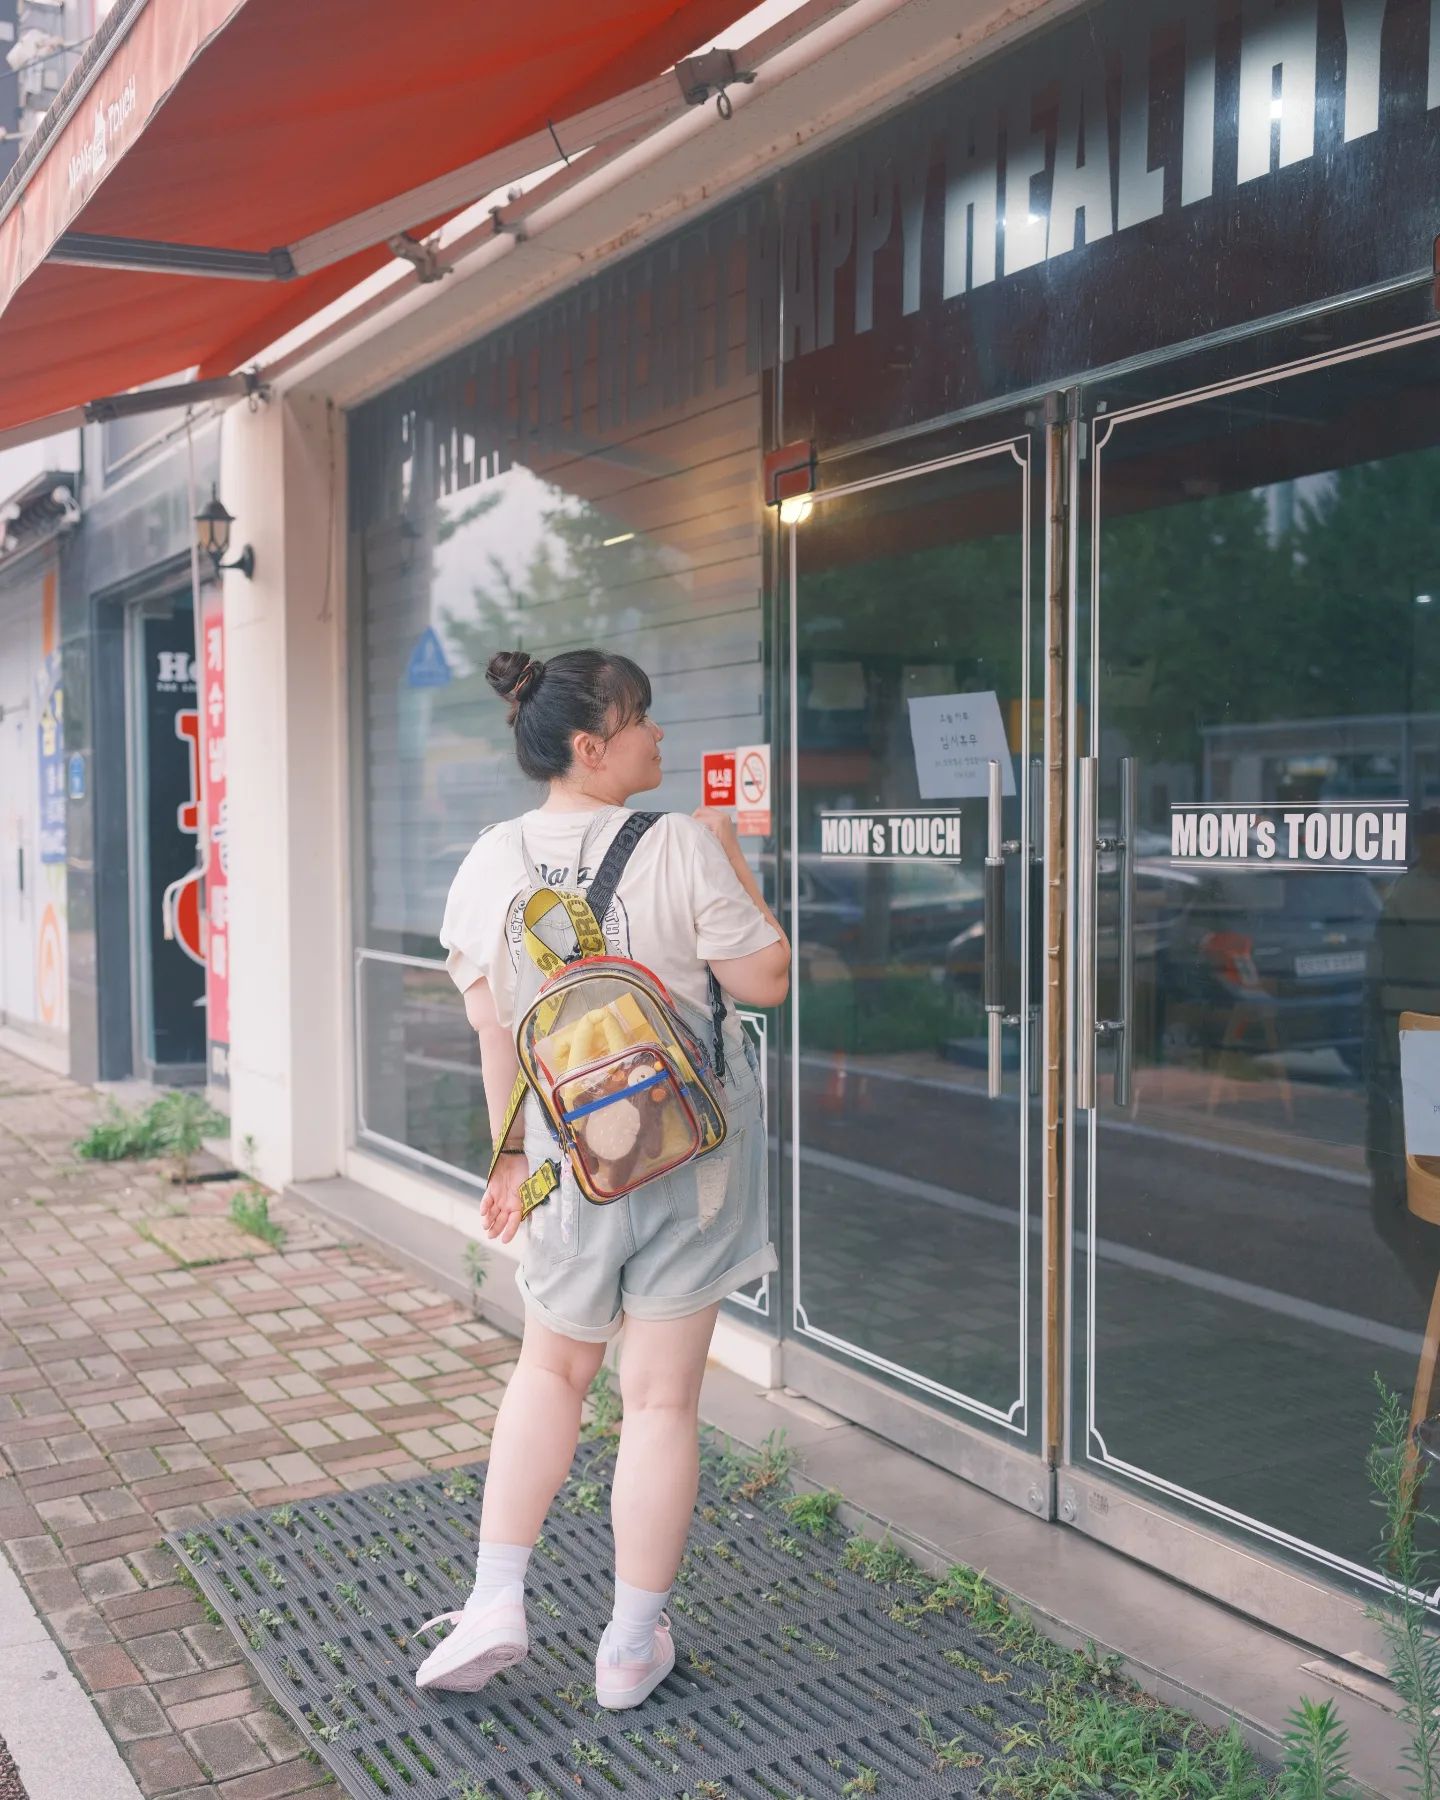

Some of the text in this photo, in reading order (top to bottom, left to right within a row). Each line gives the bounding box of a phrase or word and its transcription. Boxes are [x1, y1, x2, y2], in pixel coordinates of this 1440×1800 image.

[821, 817, 961, 856] MOM's TOUCH
[1171, 812, 1407, 861] MOM's TOUCH
